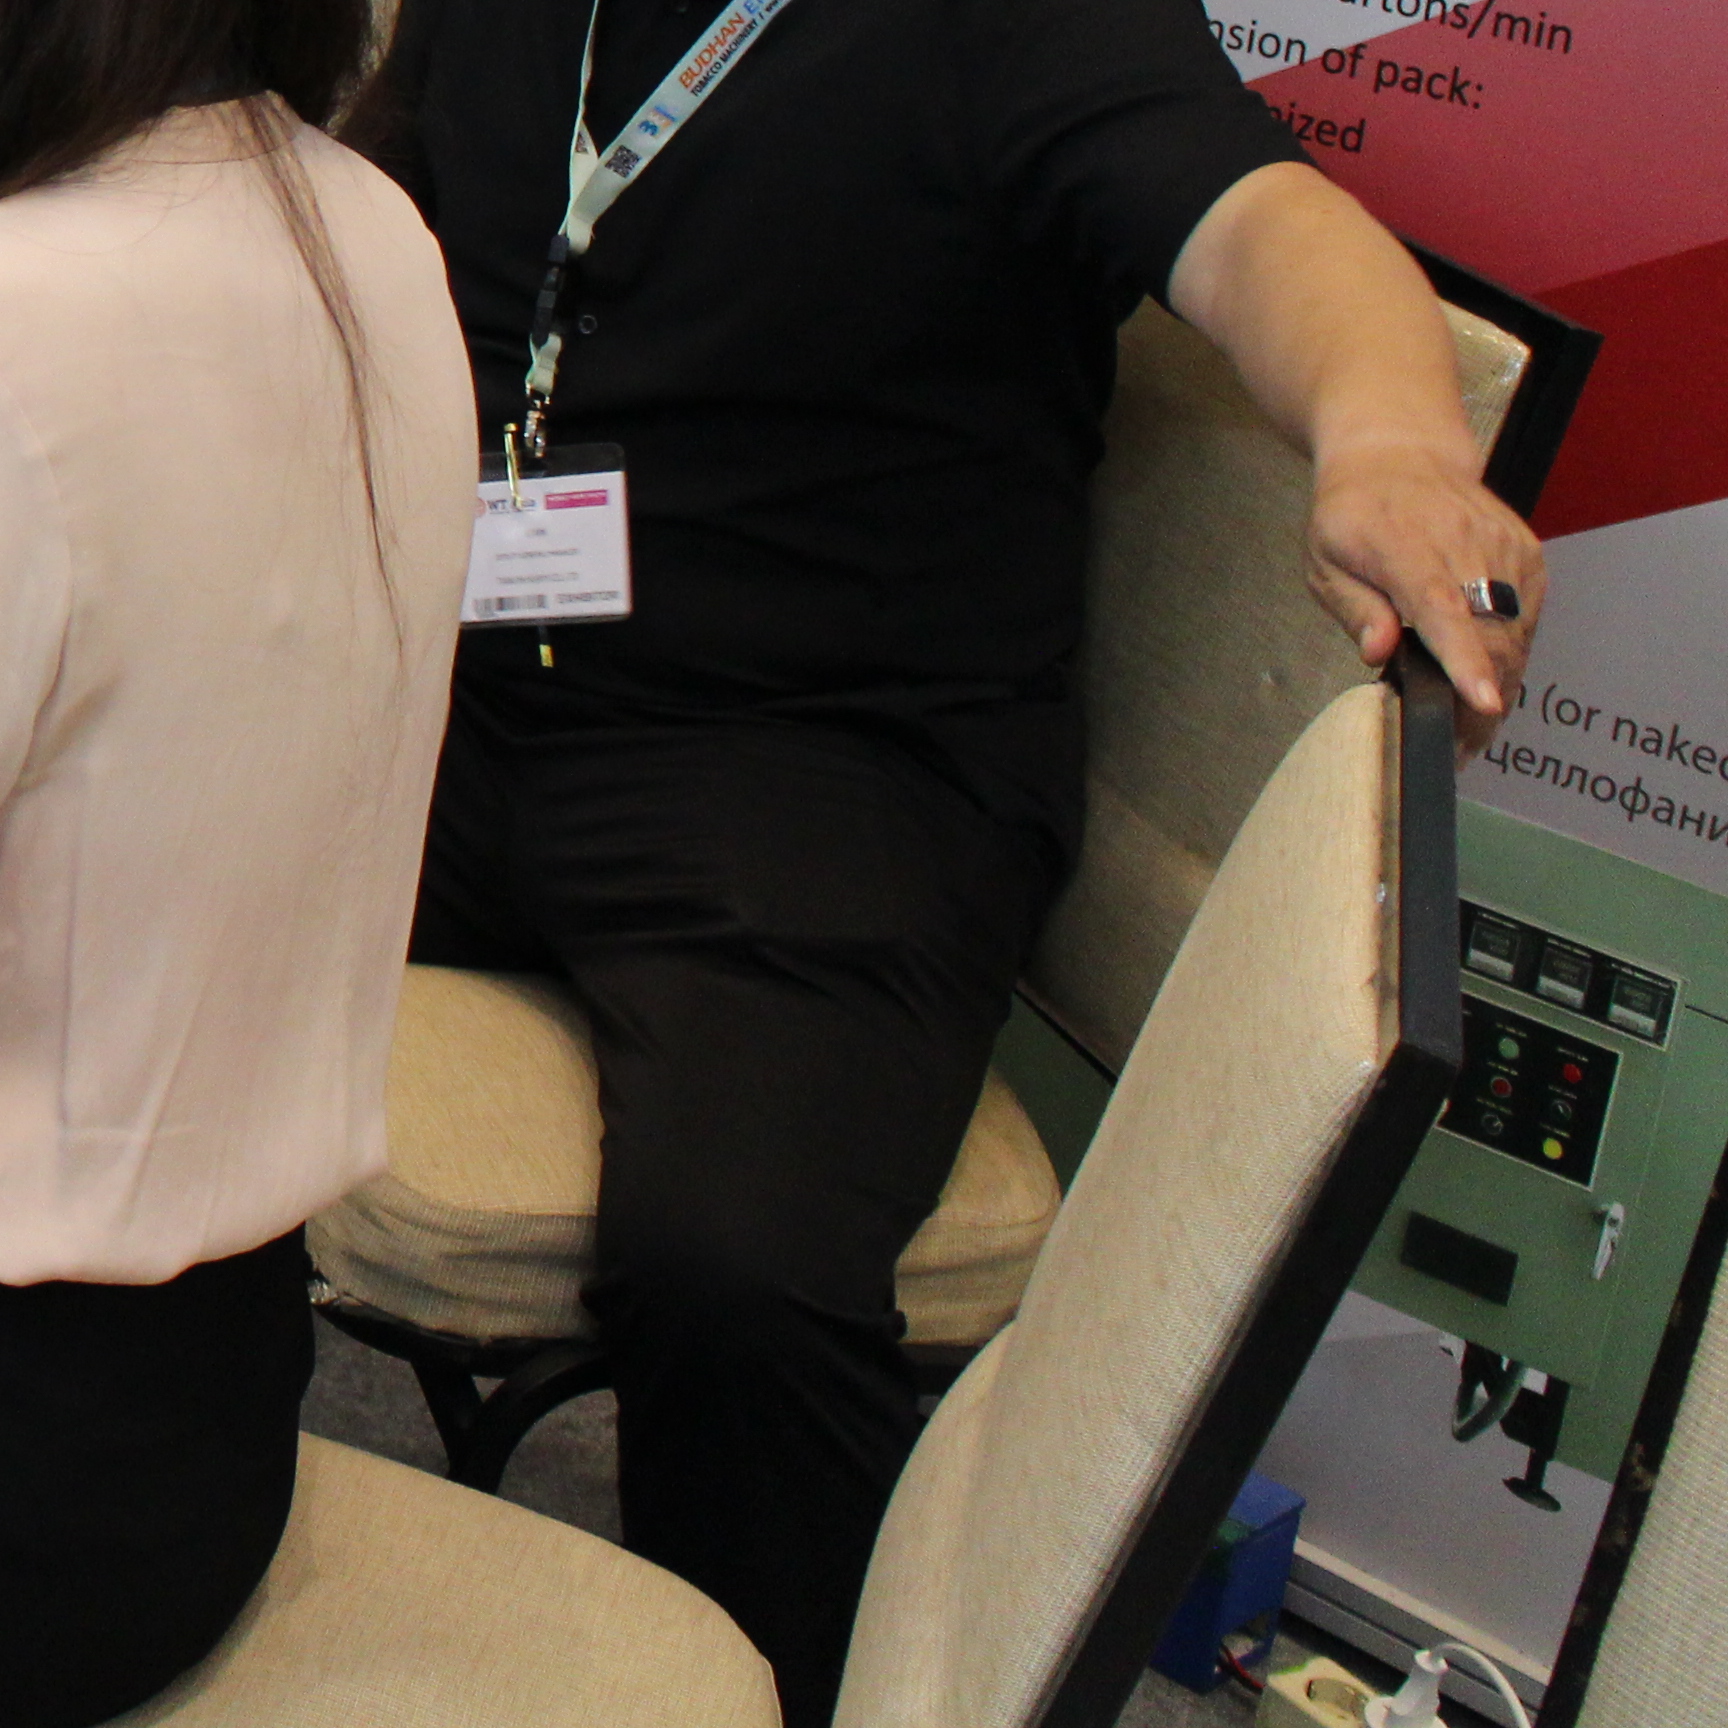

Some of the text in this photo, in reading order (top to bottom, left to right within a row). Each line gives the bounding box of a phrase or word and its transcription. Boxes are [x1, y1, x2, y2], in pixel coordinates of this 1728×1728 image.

[679, 12, 747, 88] BUDHAN
[691, 61, 722, 96] TOBACCO
[720, 19, 758, 64] MACHINERY
[1320, 43, 1367, 79] of
[1373, 55, 1485, 110] pack:
[1541, 683, 1601, 731] (or
